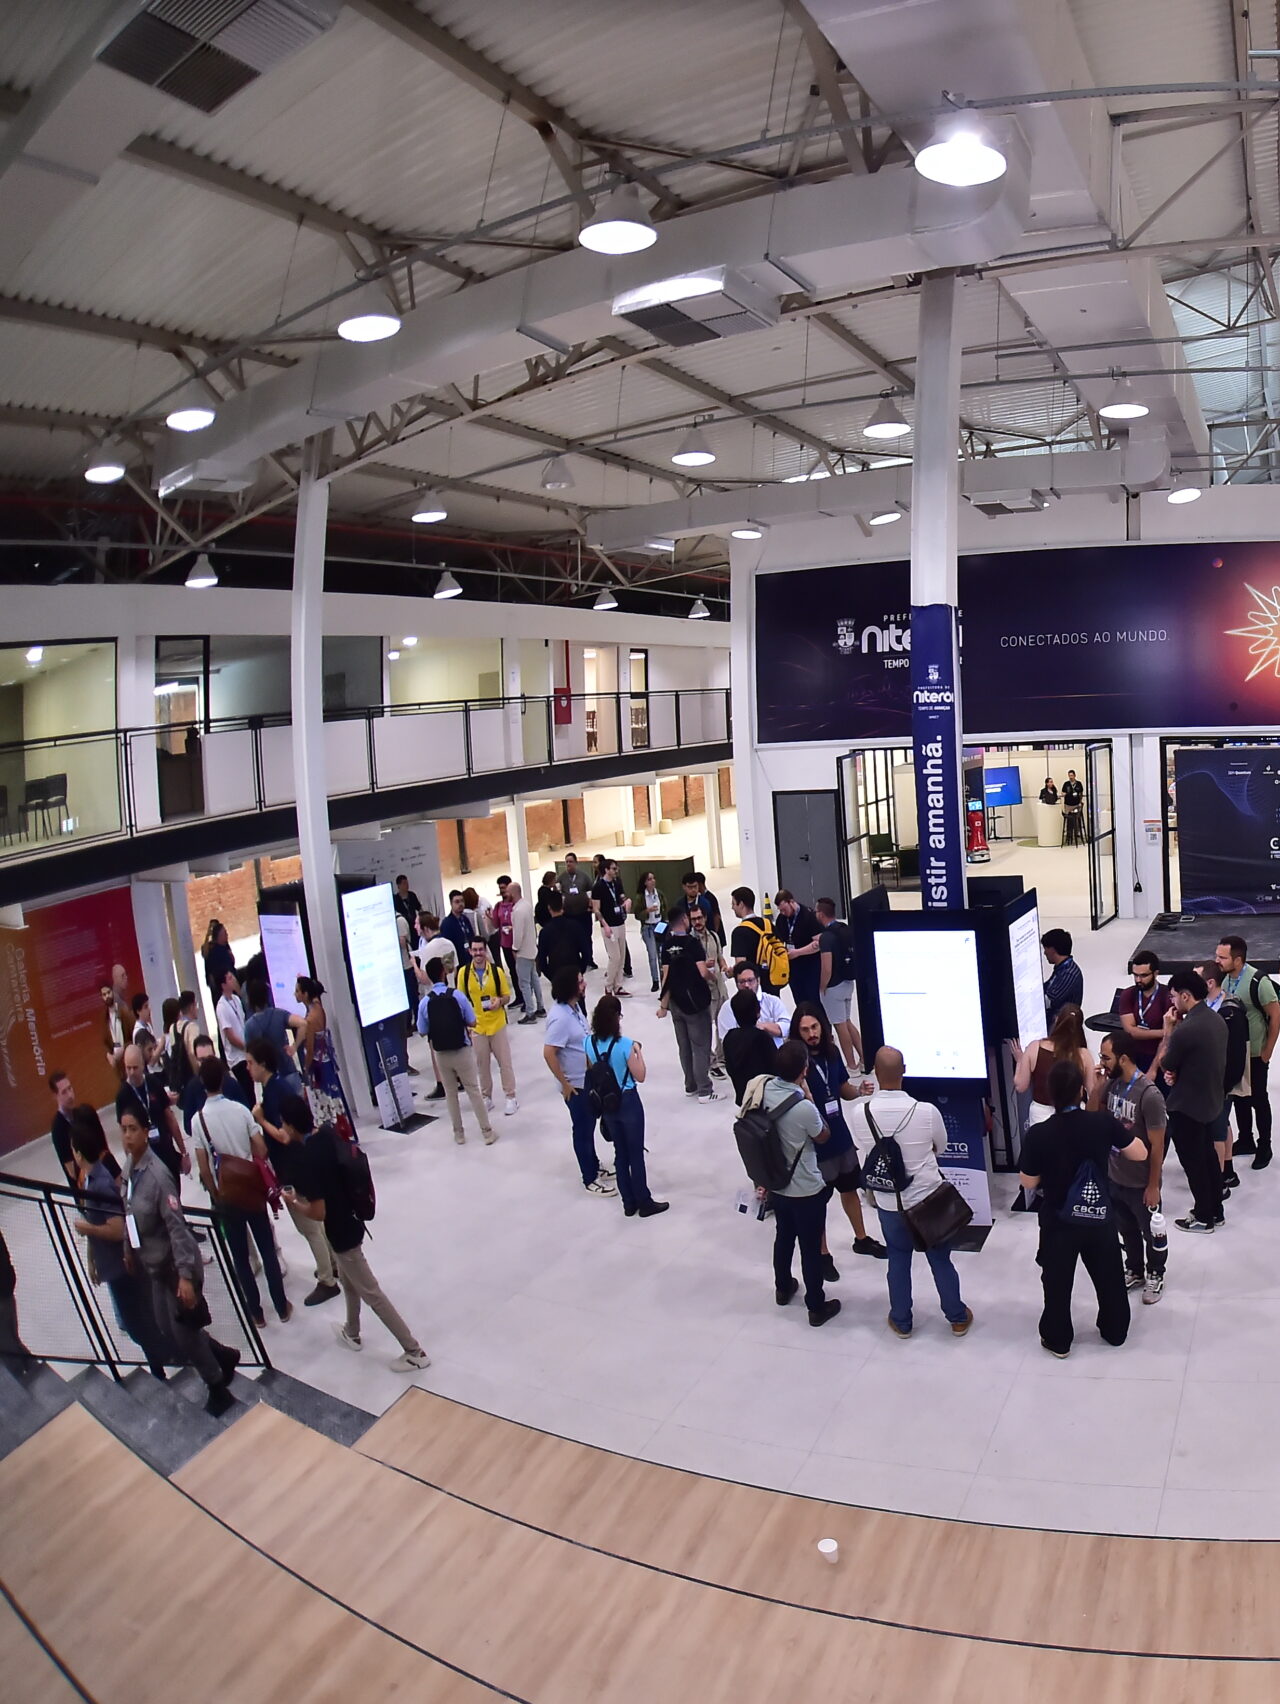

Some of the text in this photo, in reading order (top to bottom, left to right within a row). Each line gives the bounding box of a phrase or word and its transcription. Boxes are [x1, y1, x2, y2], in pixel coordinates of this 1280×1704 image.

[1000, 629, 1170, 648] CONECTADOS AO MUNDO.
[884, 659, 909, 669] TEMPO
[922, 735, 946, 849] amanhã.
[926, 857, 948, 907] istir
[945, 1142, 968, 1153] CTQ
